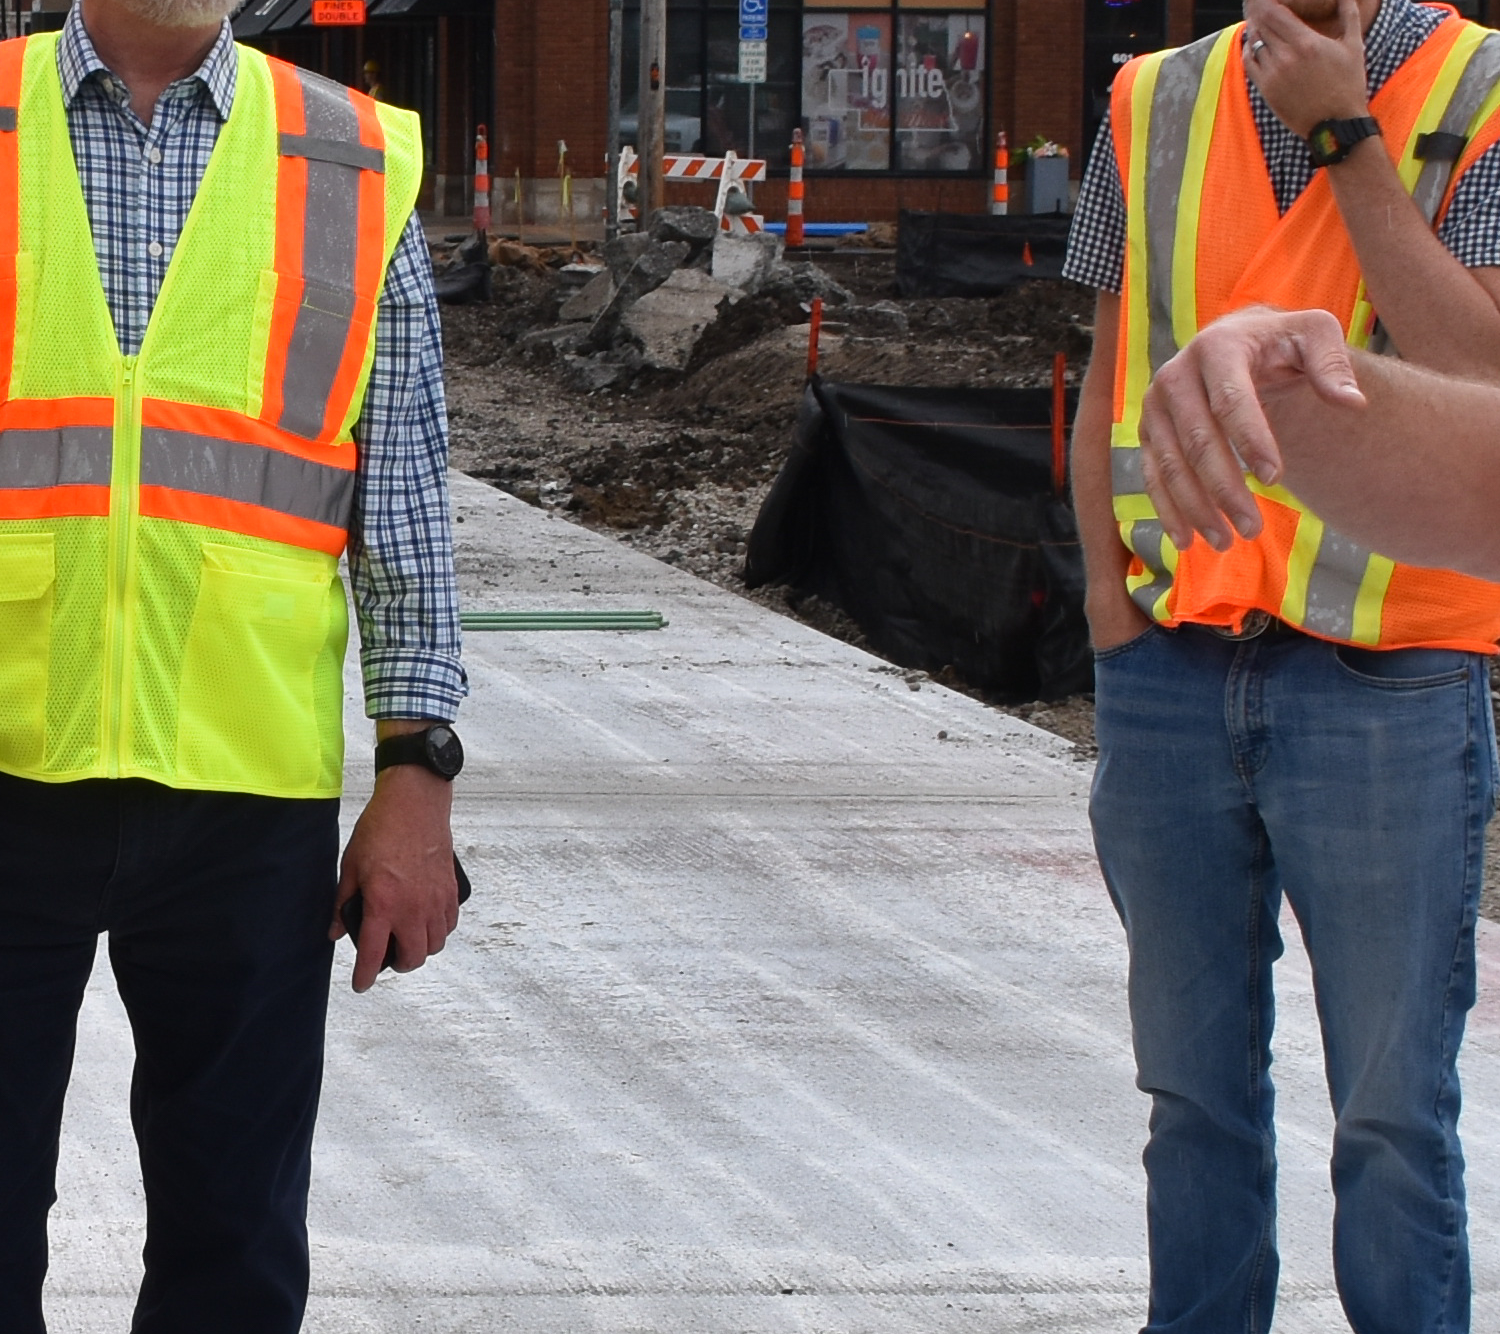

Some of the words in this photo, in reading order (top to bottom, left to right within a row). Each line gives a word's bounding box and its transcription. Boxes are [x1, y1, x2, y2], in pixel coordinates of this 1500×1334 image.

[323, 2, 354, 11] FINES
[318, 12, 359, 21] DOUBLE
[1112, 53, 1134, 64] 601
[860, 53, 944, 108] ignite
